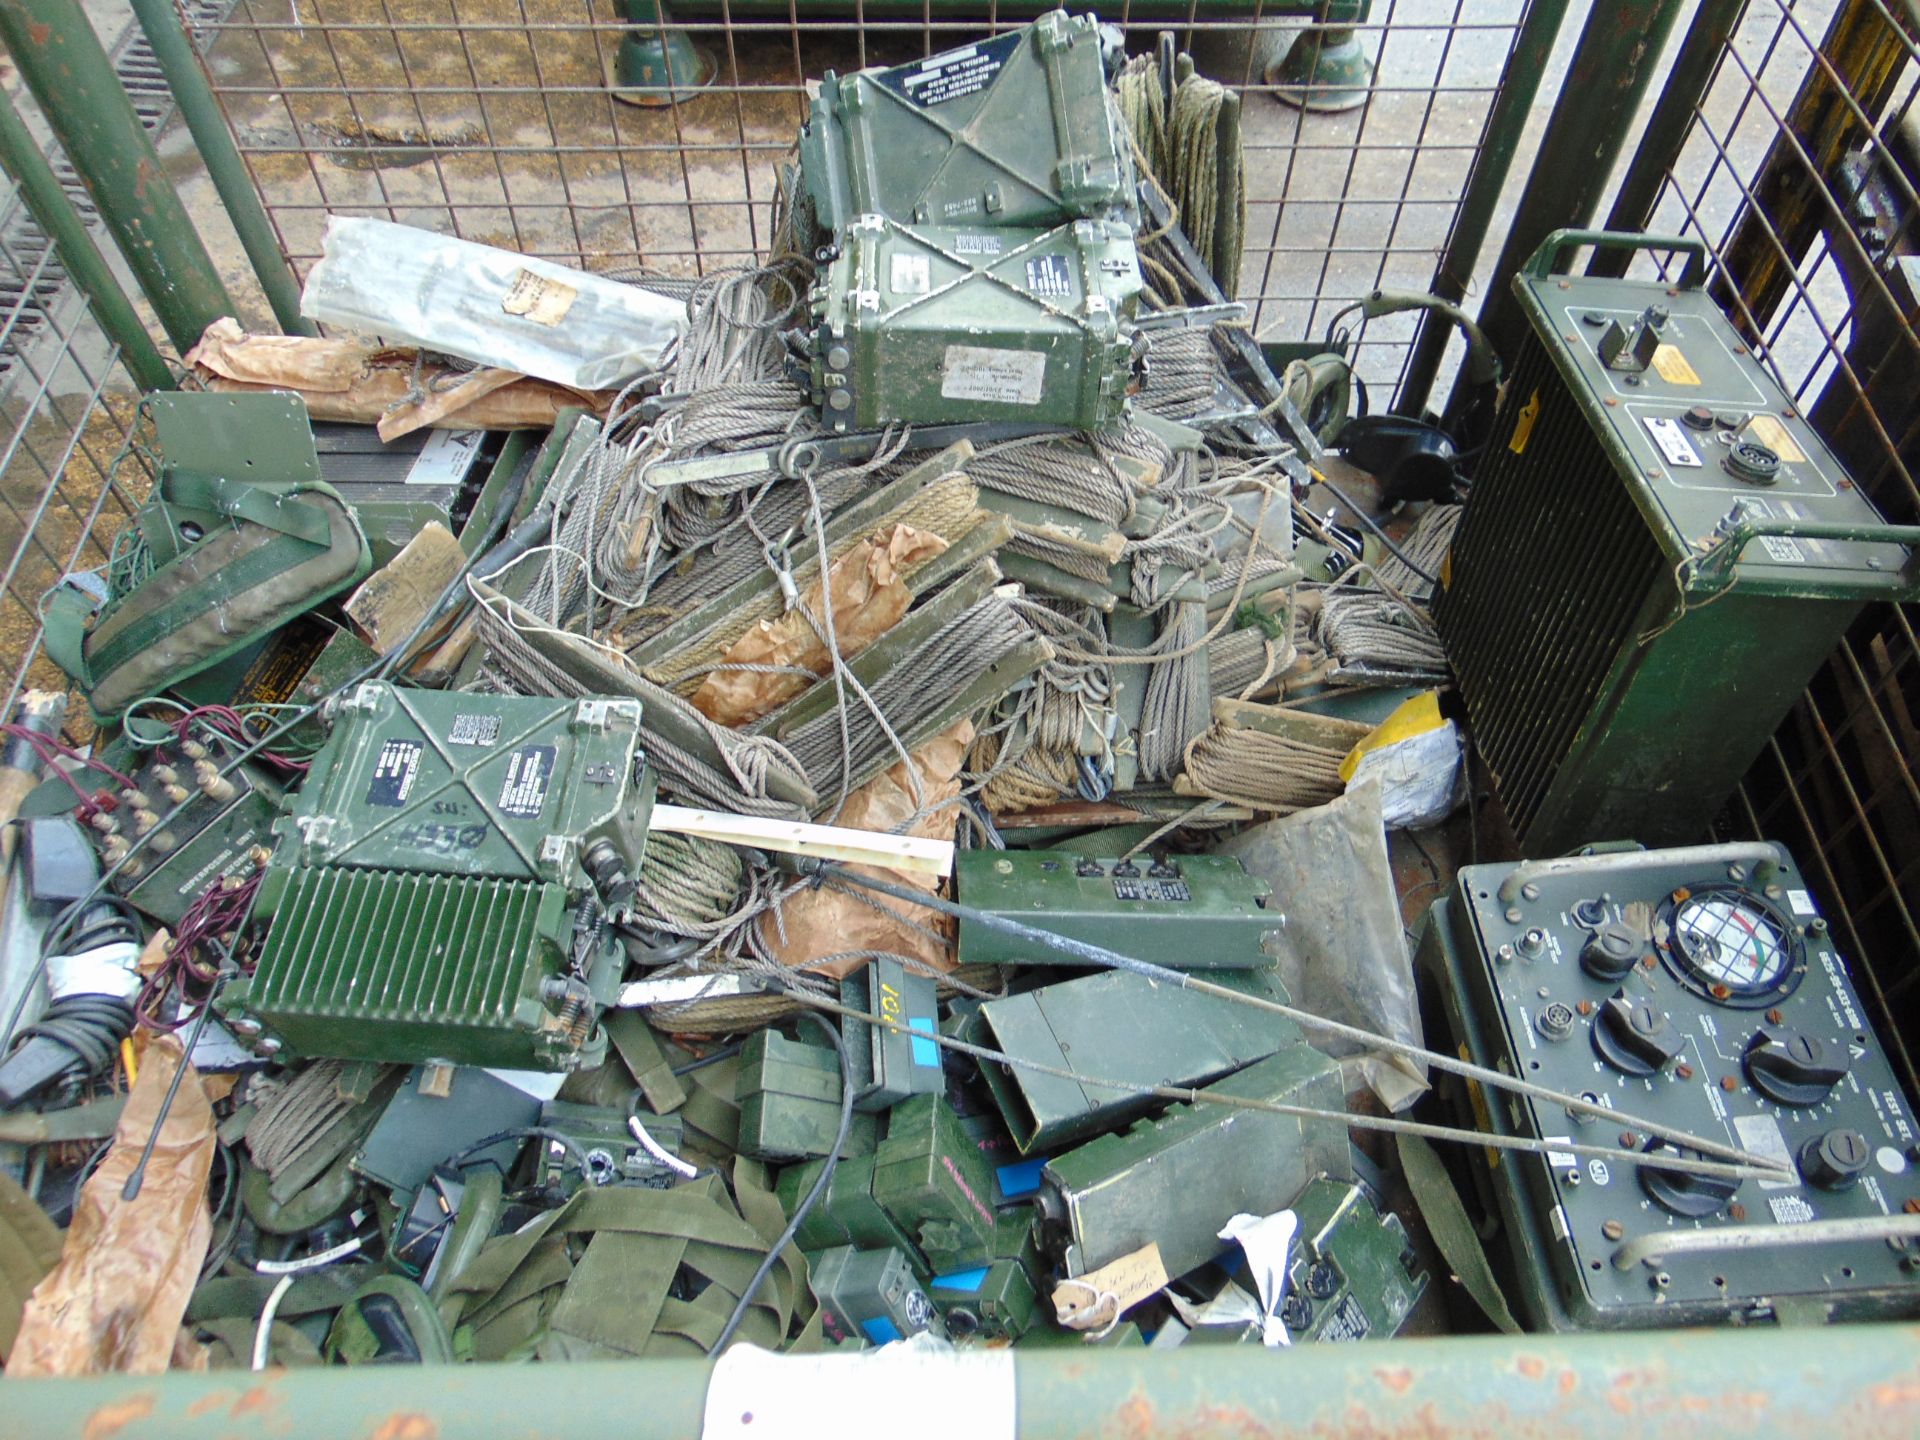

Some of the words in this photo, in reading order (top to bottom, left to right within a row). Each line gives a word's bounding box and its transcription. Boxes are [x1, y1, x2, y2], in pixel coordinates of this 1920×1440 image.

[960, 55, 990, 69] SERIAL
[947, 72, 988, 90] RECEIVER
[926, 82, 982, 104] TRANSMITTER
[179, 848, 233, 894] SUPERPOSING
[236, 828, 255, 845] UNIT
[1882, 1089, 1901, 1118] TEST
